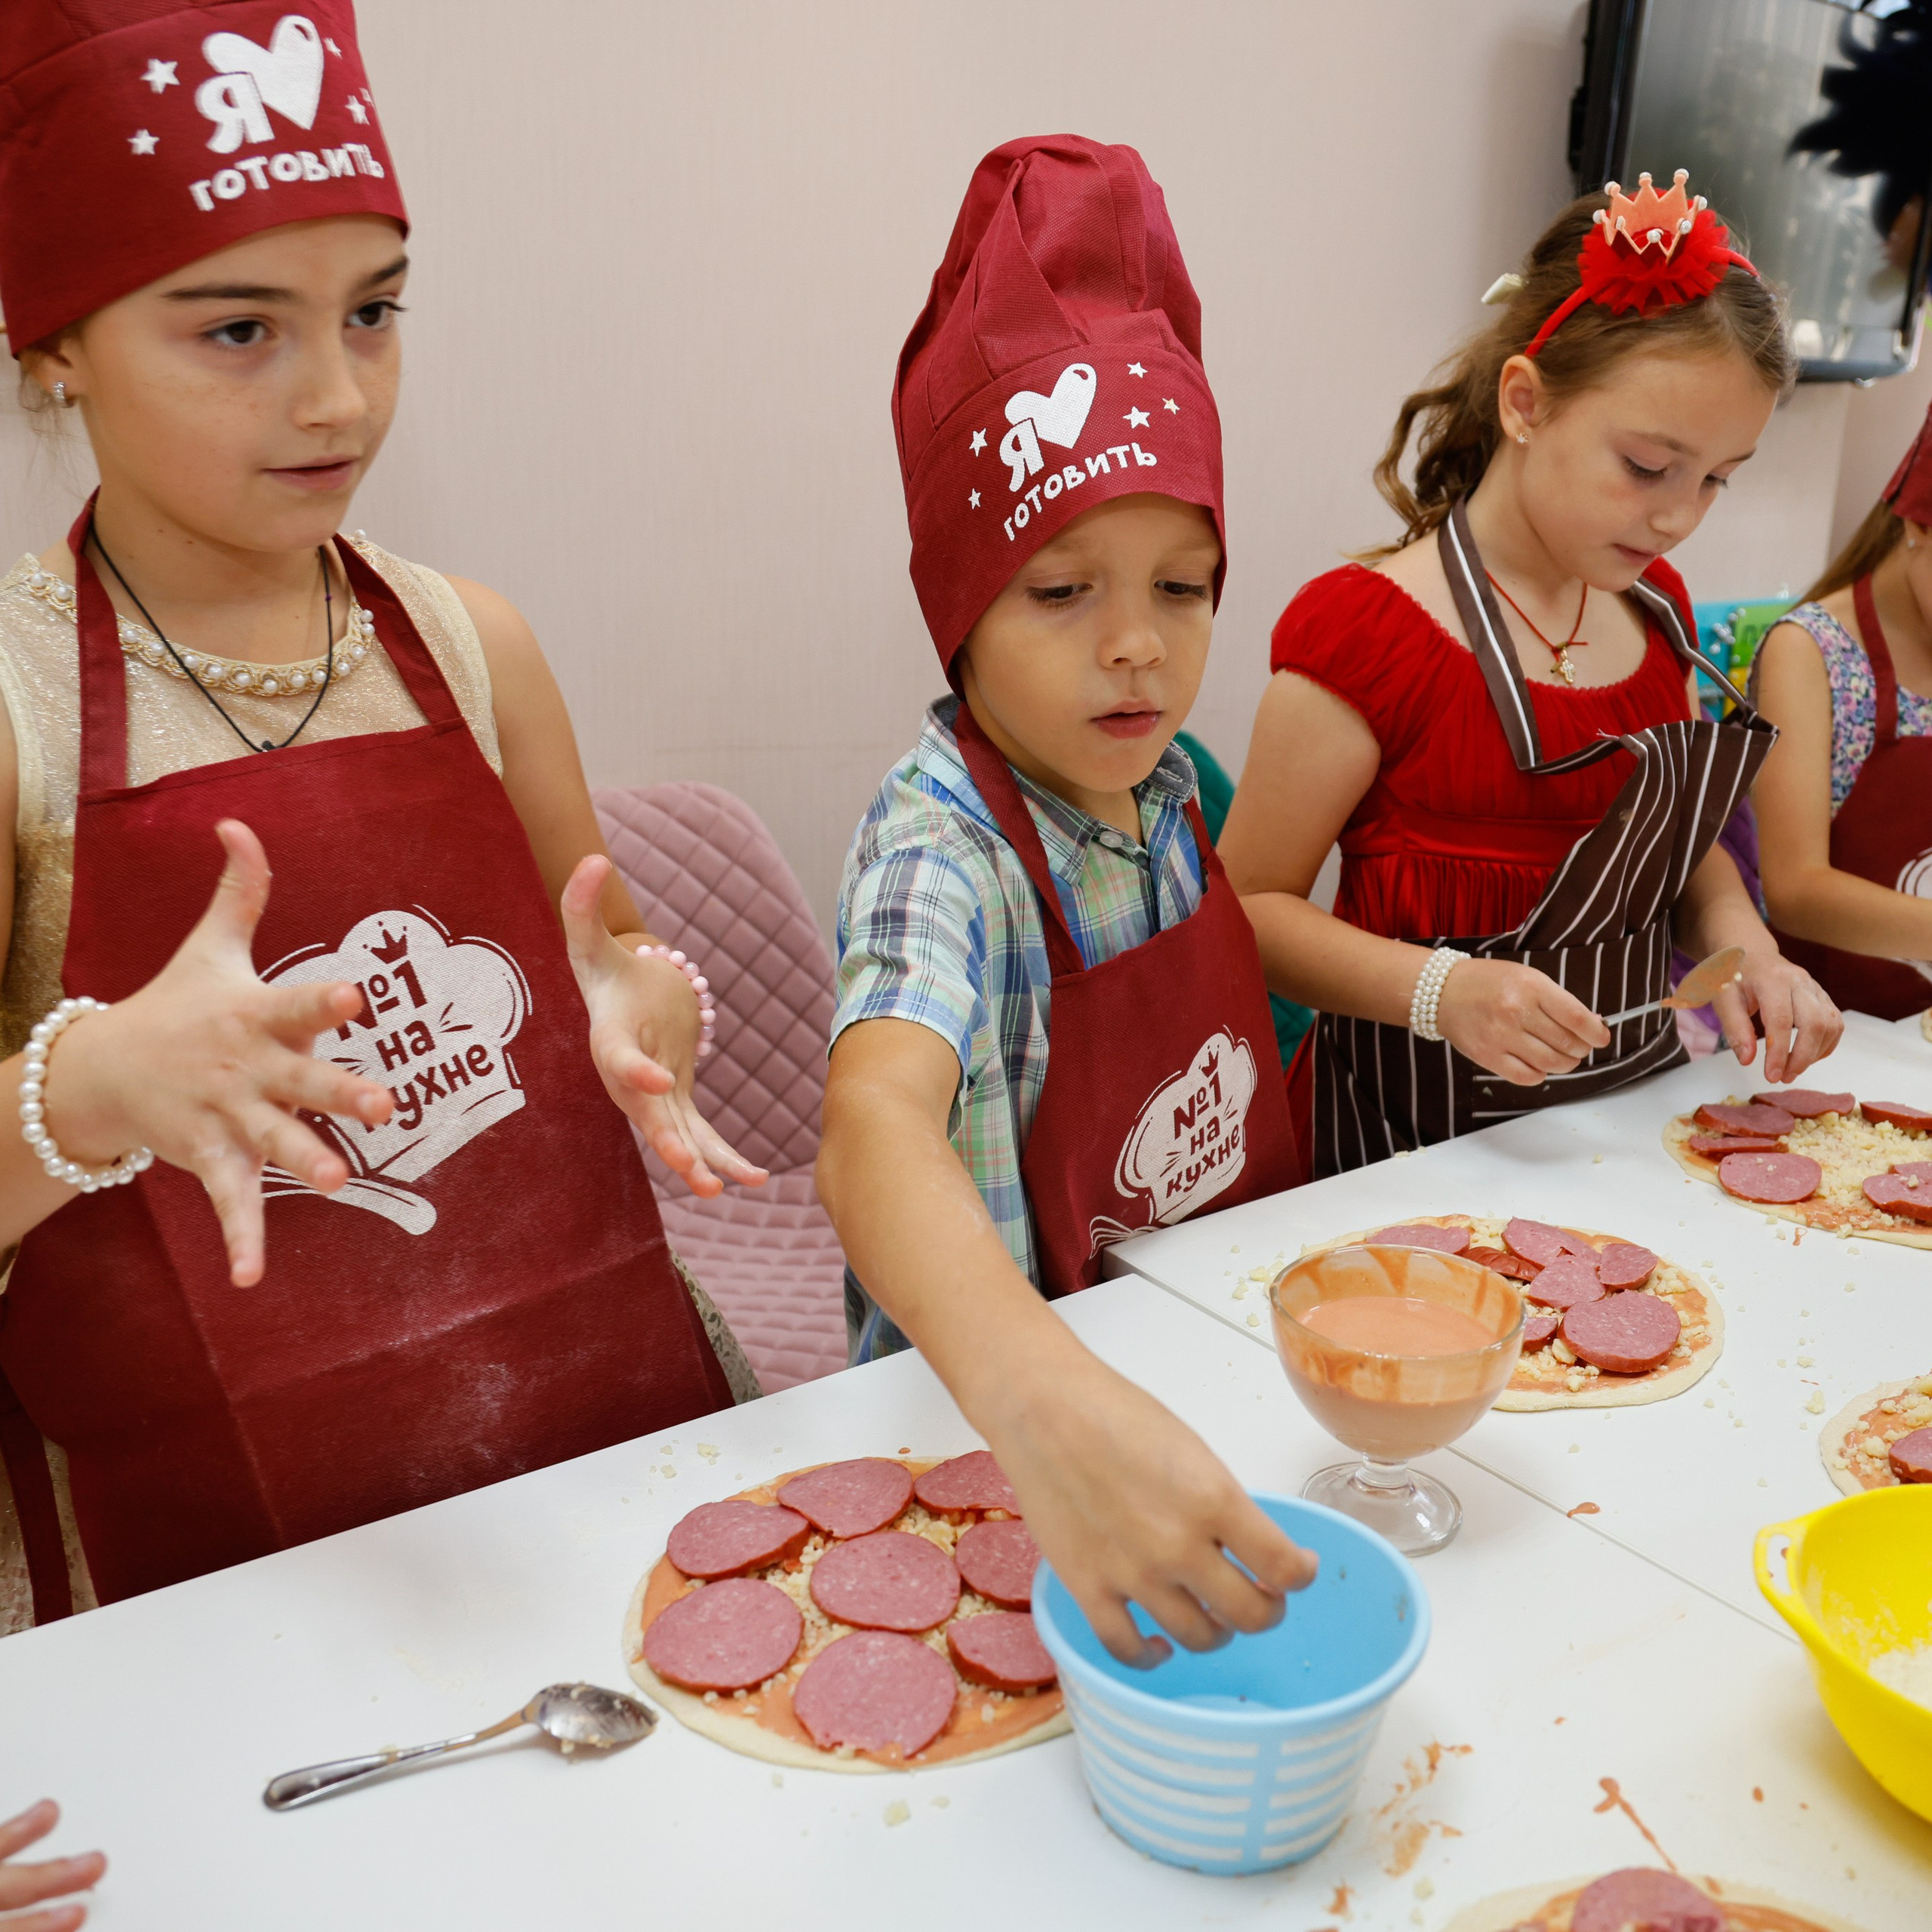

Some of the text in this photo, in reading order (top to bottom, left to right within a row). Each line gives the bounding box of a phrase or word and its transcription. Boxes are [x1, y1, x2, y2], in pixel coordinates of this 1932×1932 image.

[194, 72, 275, 154] Я
[998, 417, 1045, 493] Я
[1003, 441, 1158, 542] ГОТОВИТЬ
[375, 1020, 436, 1072] на
[361, 1044, 495, 1134] ухне
[1165, 1123, 1241, 1198] кухне
[1189, 1115, 1221, 1156] на
